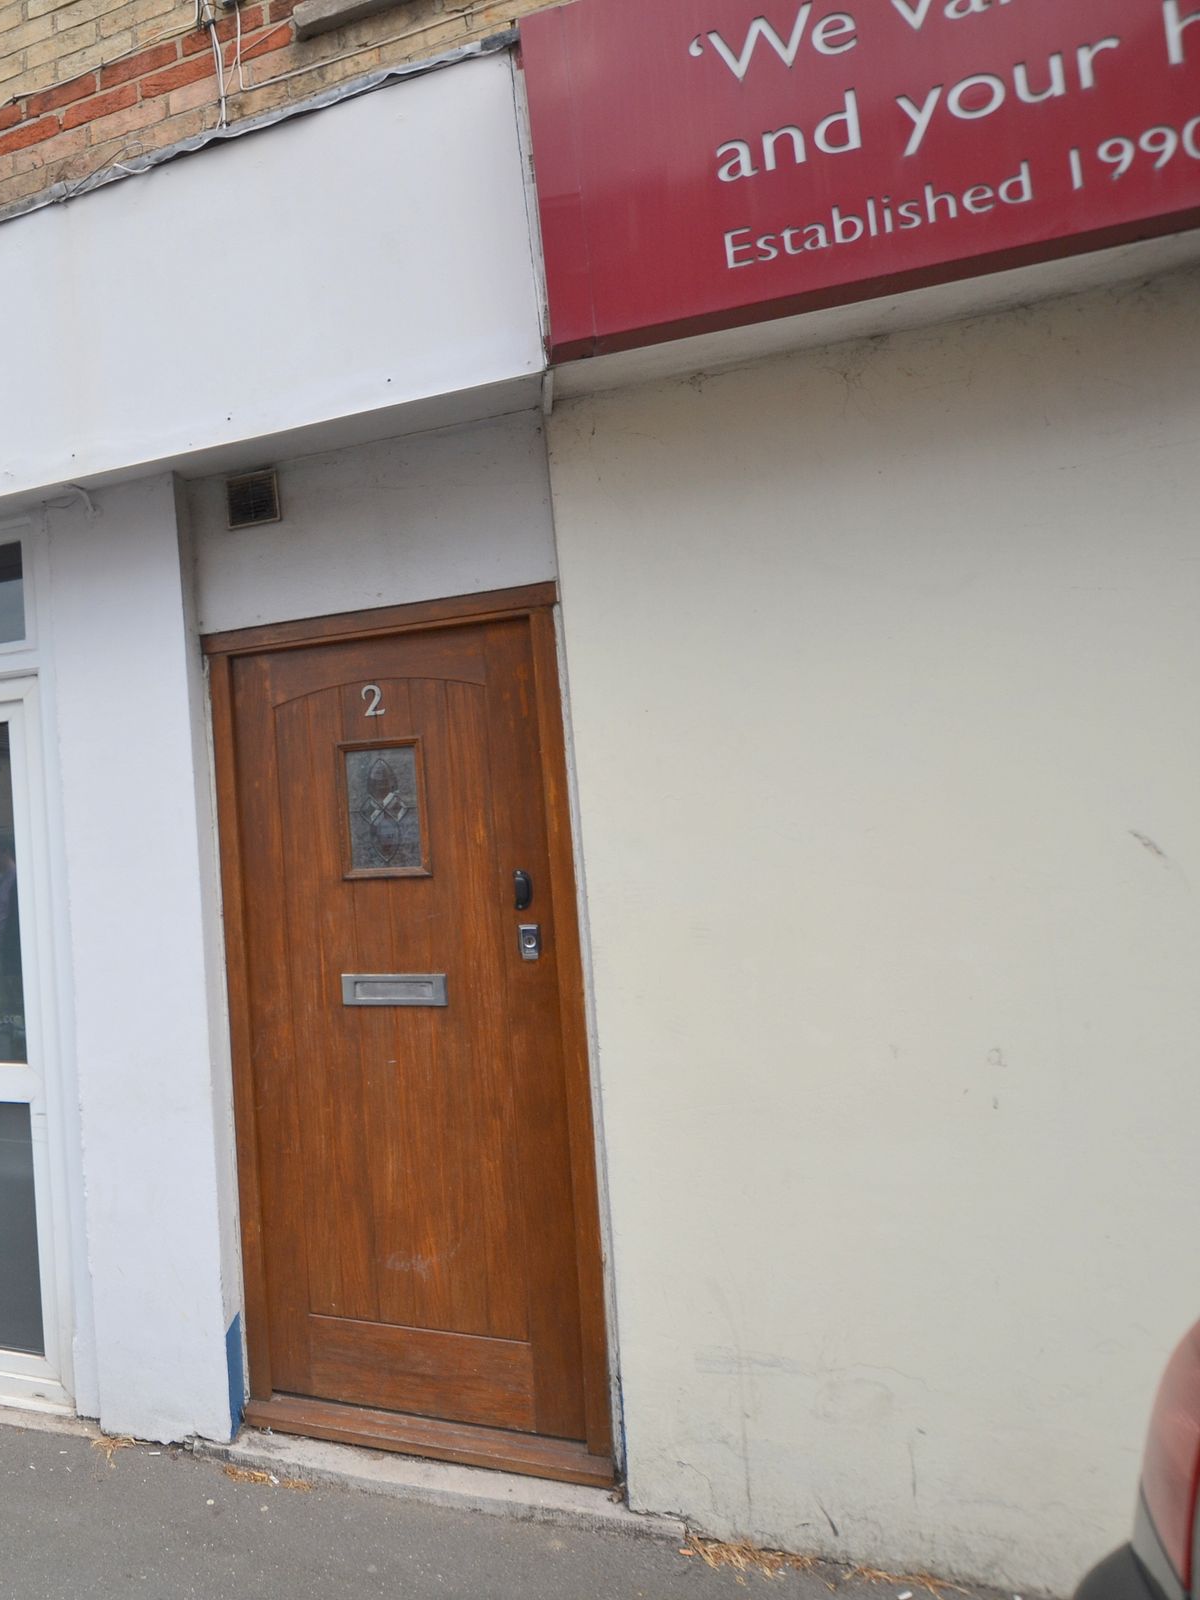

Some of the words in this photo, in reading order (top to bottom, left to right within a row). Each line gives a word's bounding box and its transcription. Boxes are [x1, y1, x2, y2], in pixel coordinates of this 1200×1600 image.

[716, 87, 862, 183] and
[895, 36, 1121, 157] your
[724, 160, 1033, 269] Established
[361, 684, 386, 717] 2
